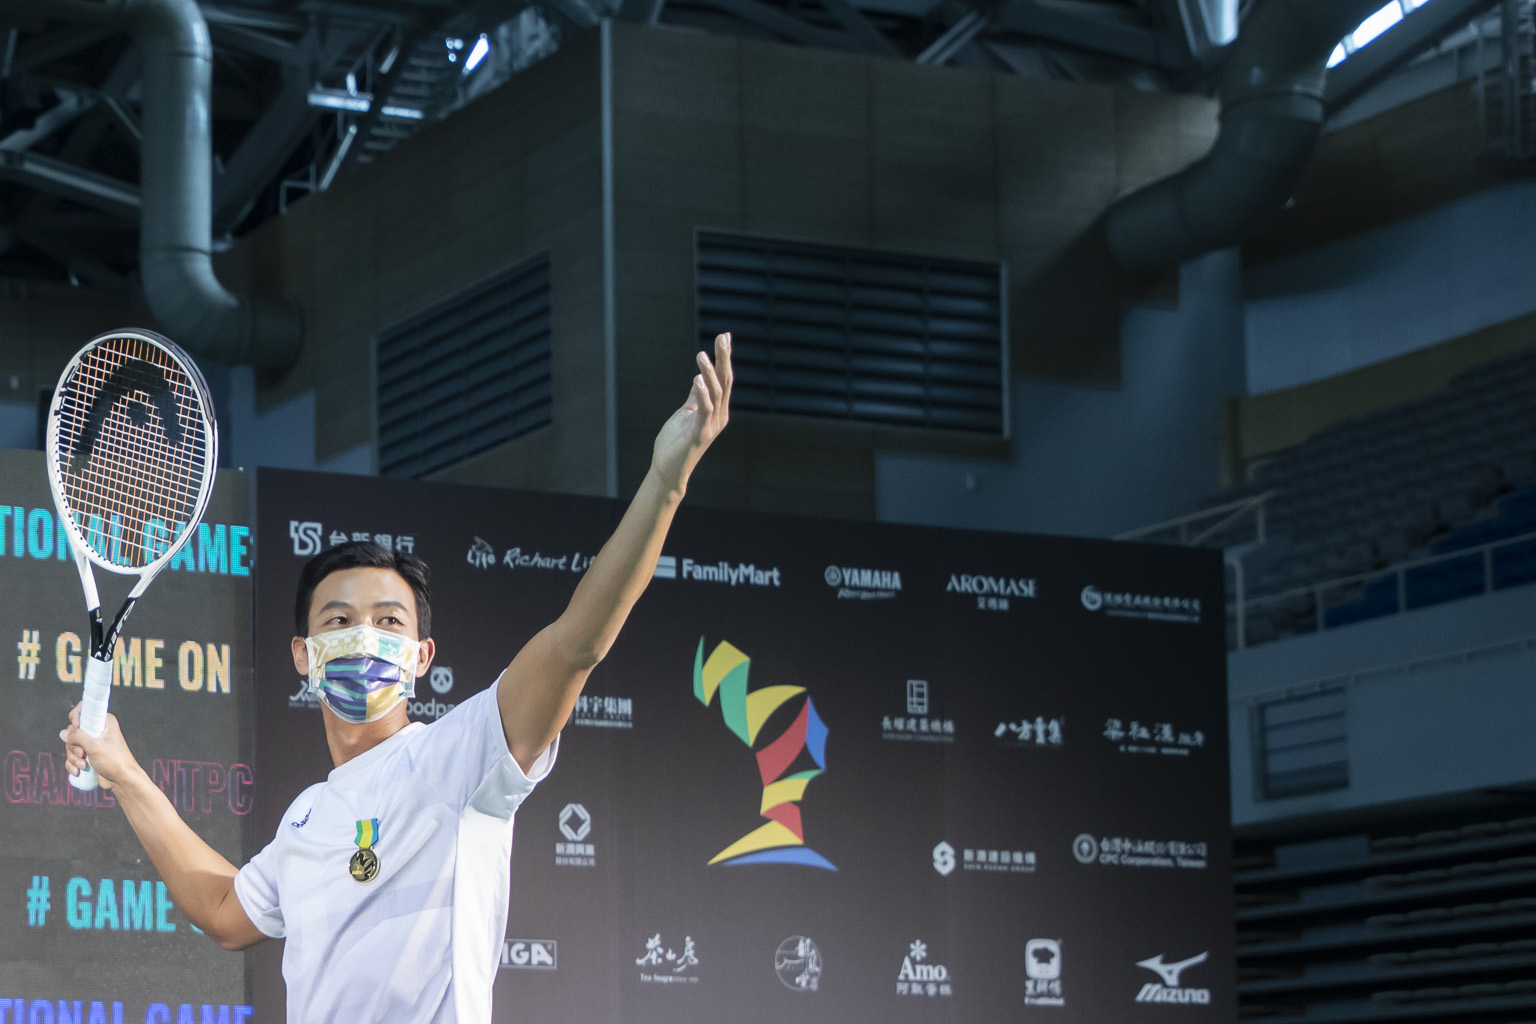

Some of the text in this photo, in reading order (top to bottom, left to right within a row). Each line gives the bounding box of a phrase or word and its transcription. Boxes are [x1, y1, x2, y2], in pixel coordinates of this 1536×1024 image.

[141, 521, 254, 576] GAME
[682, 558, 781, 587] FamilyMart
[841, 567, 902, 590] YAMAHA
[946, 573, 1037, 598] AROMASE
[56, 631, 164, 689] GME
[179, 640, 231, 694] ON
[67, 876, 174, 932] GAME
[898, 954, 950, 982] Amo
